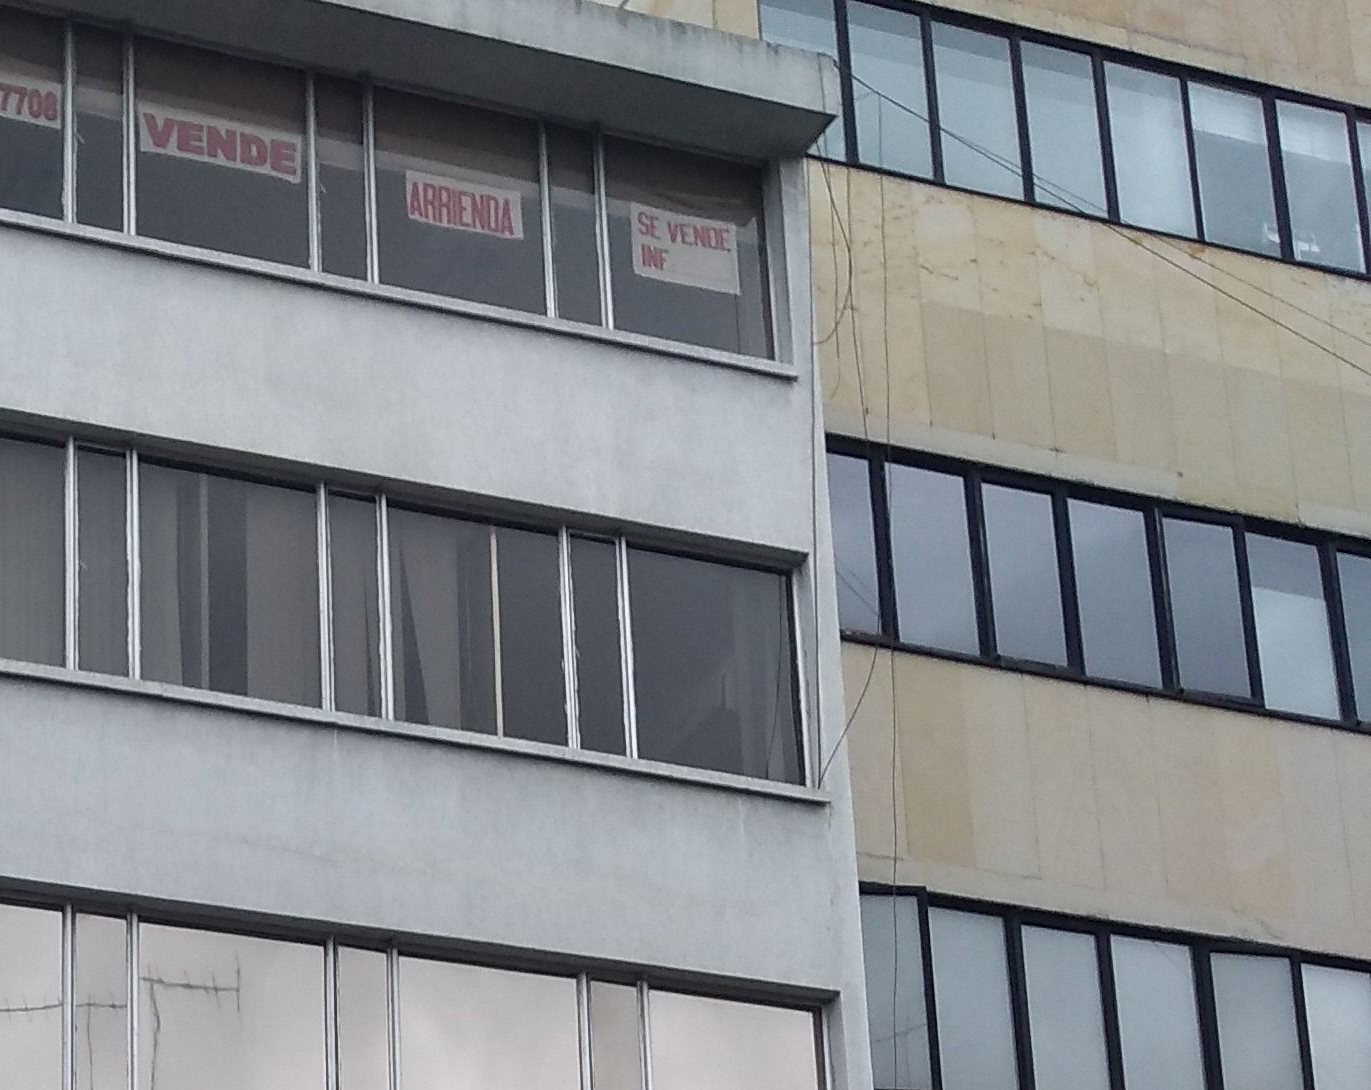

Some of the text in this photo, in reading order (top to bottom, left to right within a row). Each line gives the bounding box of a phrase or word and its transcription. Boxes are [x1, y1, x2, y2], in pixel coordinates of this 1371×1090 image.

[142, 112, 297, 176] VENDE
[409, 181, 515, 237] ARRIENDA
[638, 212, 731, 252] SE VENDE
